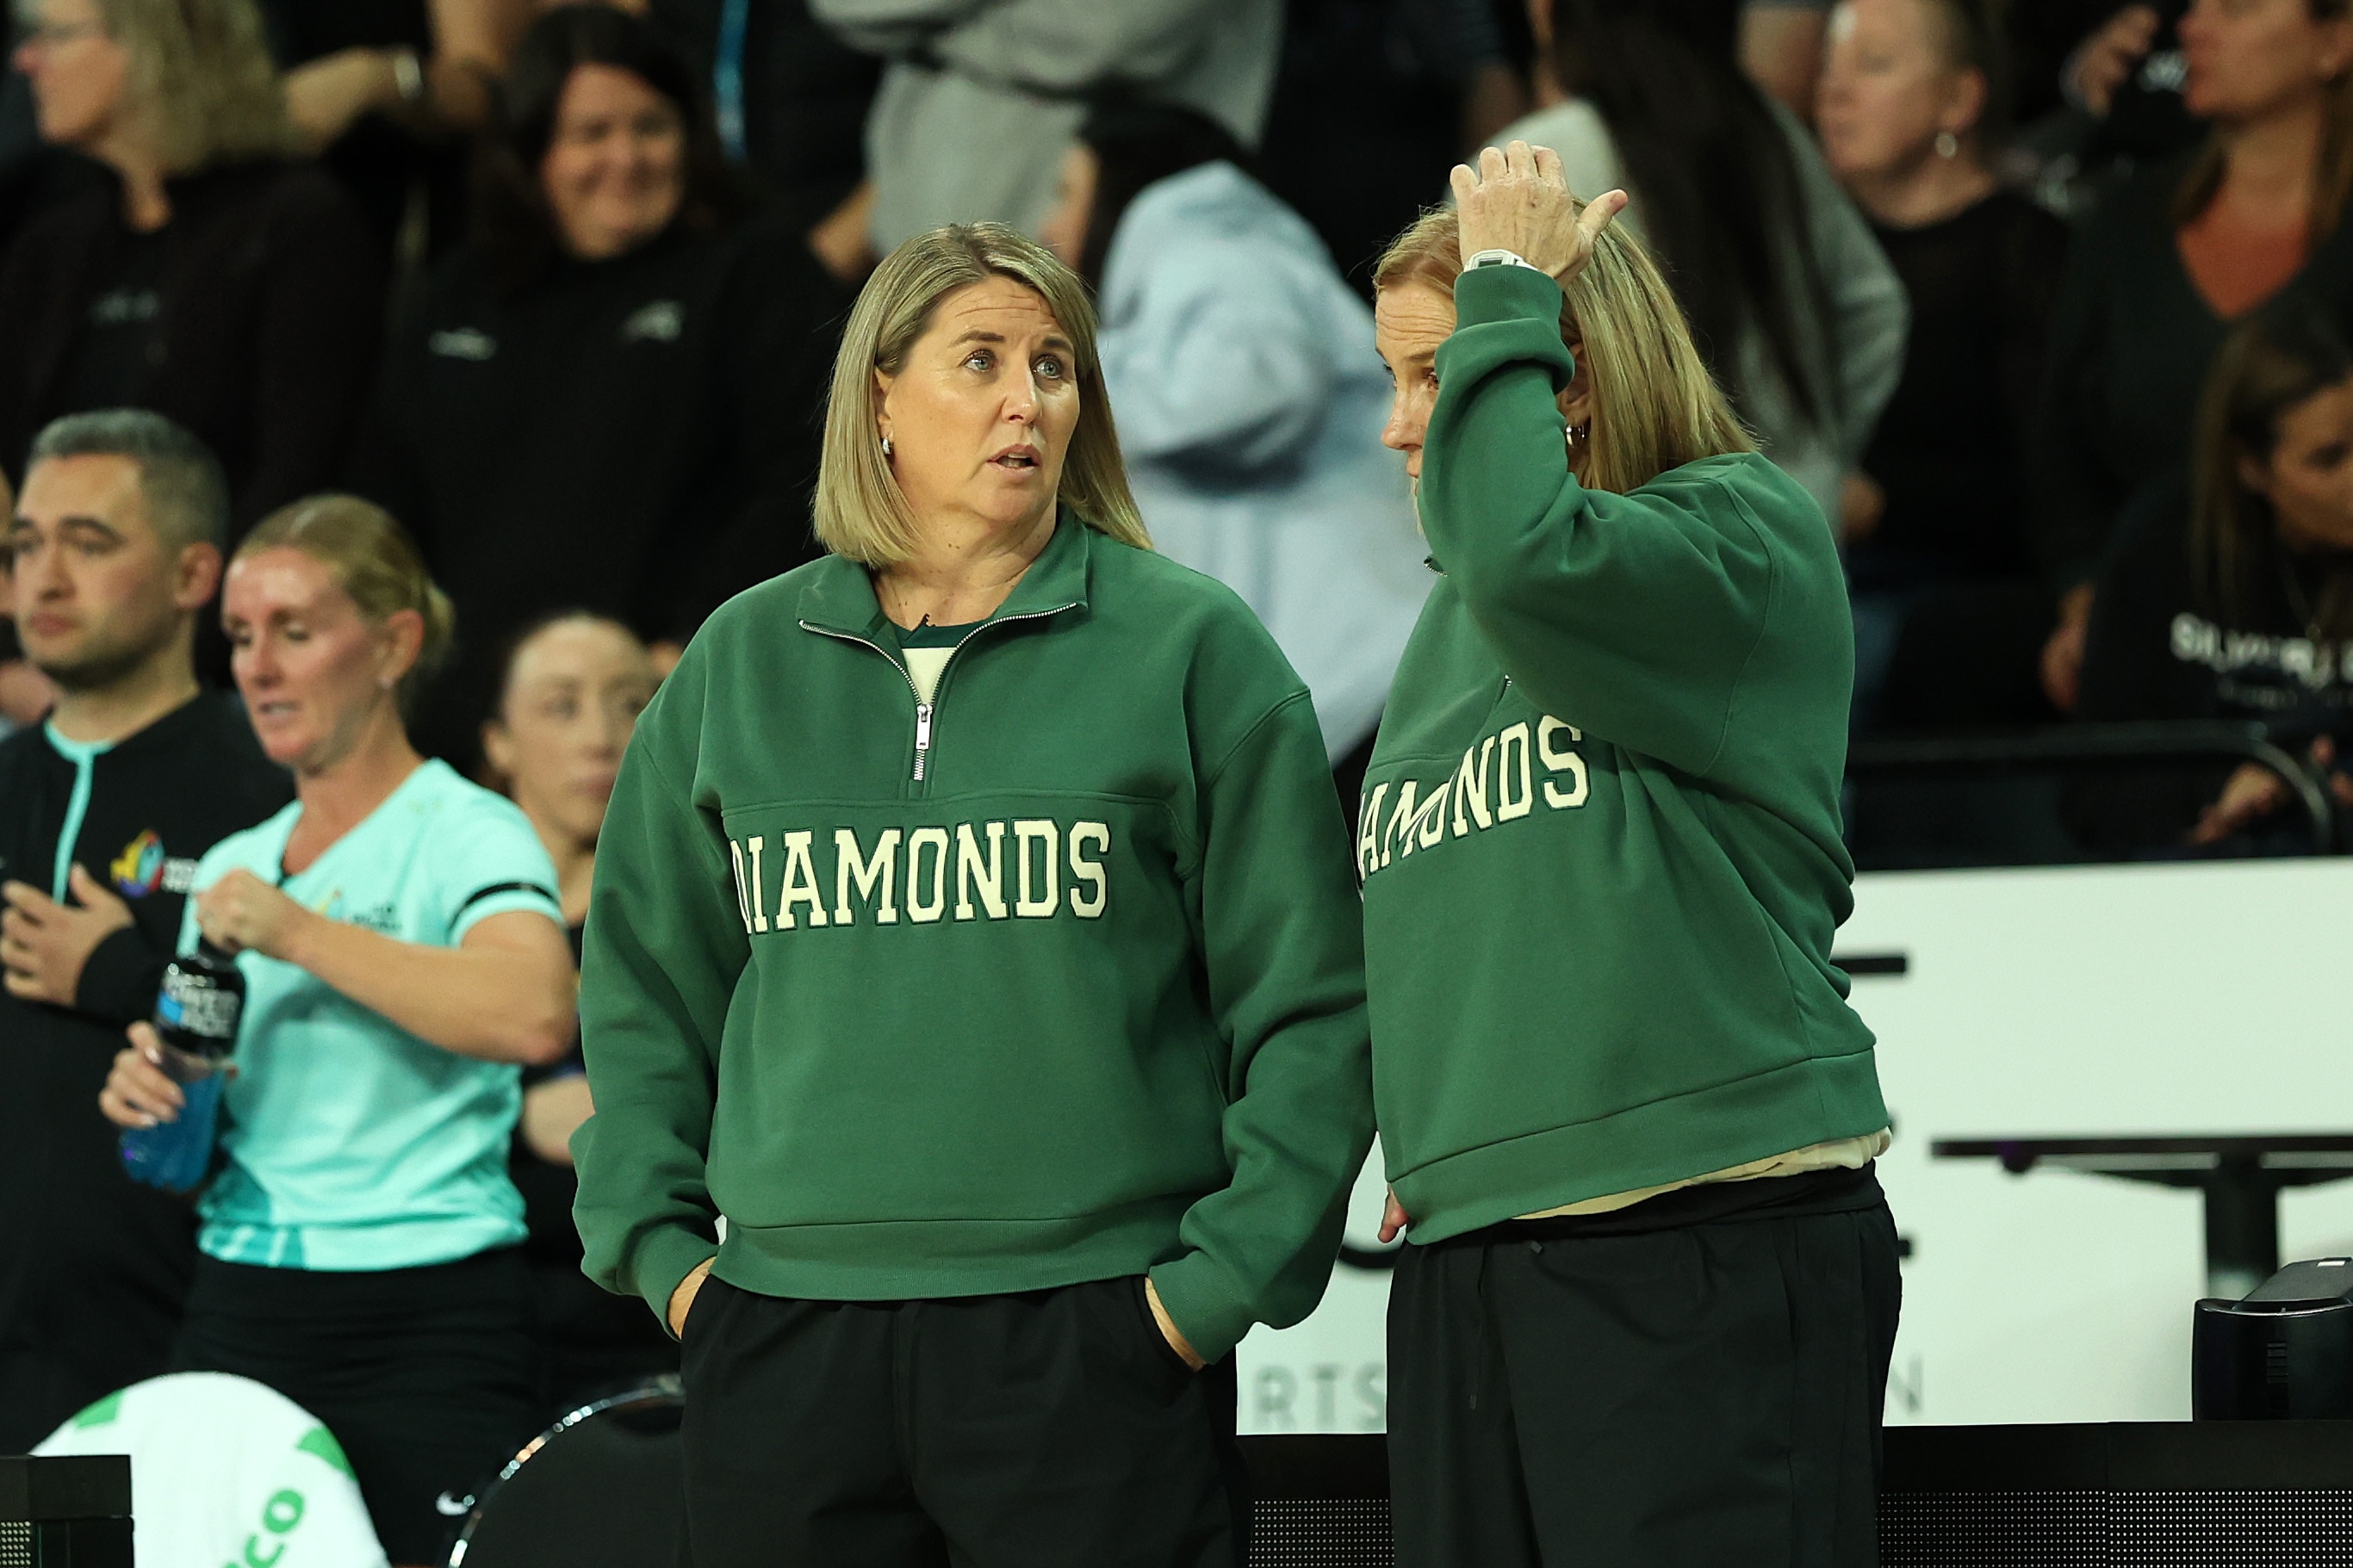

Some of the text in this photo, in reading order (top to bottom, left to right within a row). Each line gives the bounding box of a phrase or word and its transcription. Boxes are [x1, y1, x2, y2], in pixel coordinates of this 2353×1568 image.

[1357, 715, 1590, 882] AMONDS
[730, 818, 1111, 934] DIAMONDS
[222, 1489, 305, 1568] co
